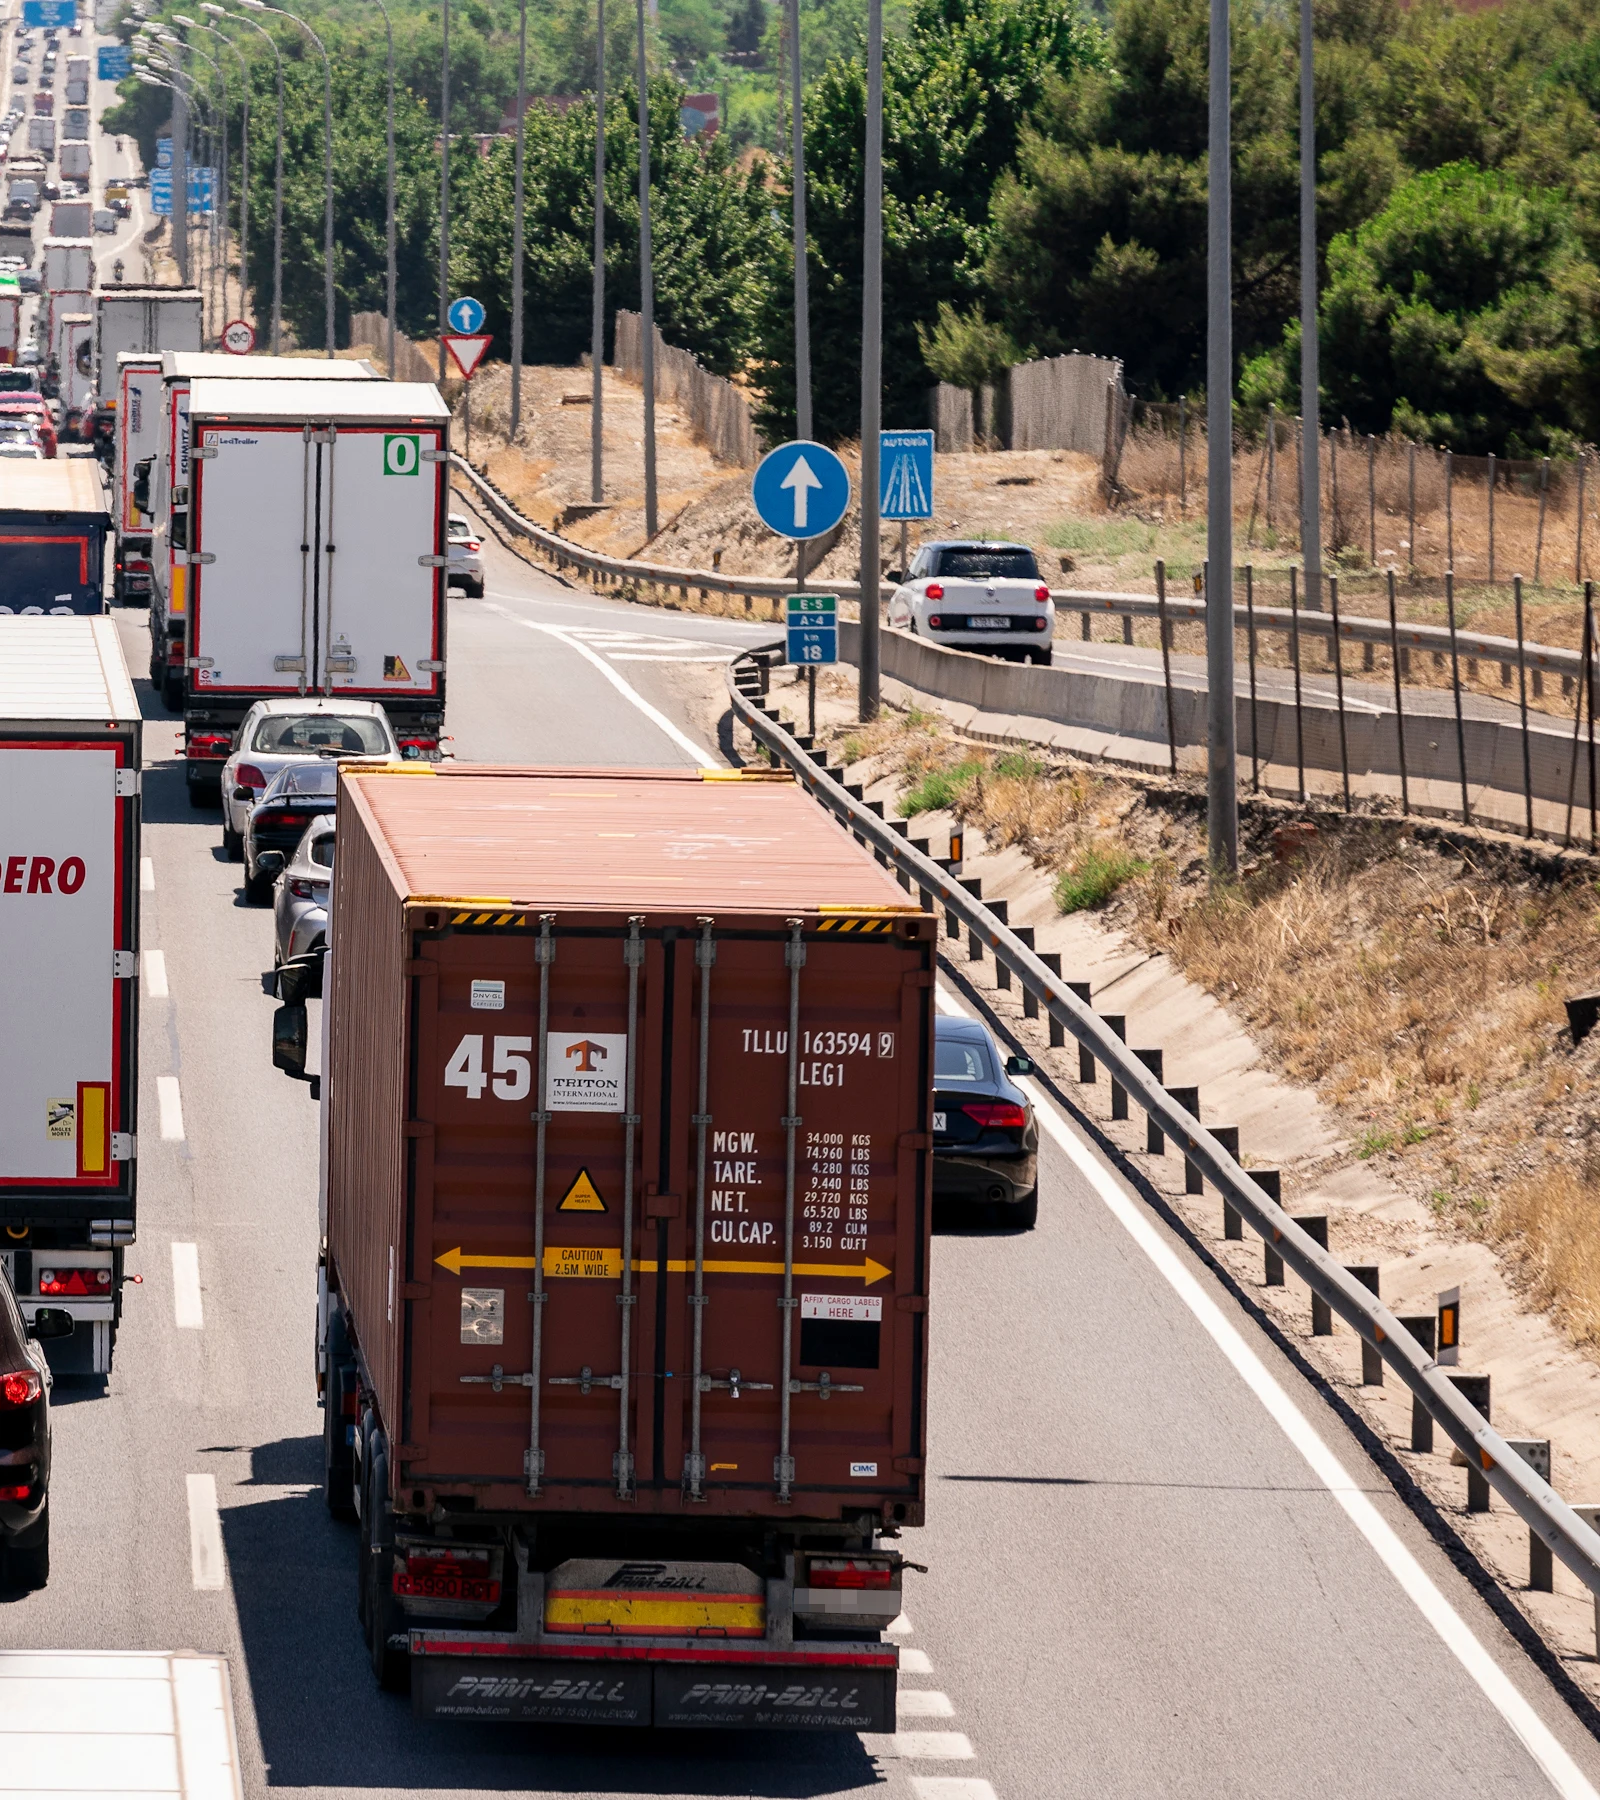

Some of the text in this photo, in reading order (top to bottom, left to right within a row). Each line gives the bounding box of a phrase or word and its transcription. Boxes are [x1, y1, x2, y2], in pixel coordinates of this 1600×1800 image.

[180, 429, 189, 474] SCHMITZ
[387, 437, 416, 473] 0
[800, 599, 824, 610] E-5
[800, 615, 824, 625] A-4
[802, 645, 822, 660] 18
[742, 1029, 892, 1056] TLLU 163594 9
[444, 1034, 532, 1100] 45
[800, 1062, 844, 1087] LEG1
[553, 1078, 618, 1088] TRITON
[553, 1090, 618, 1098] INTERNATIONAL
[713, 1131, 758, 1153] MGW.
[852, 1134, 871, 1146] KGS
[851, 1148, 870, 1160] LBS
[713, 1161, 762, 1184] TARE.
[851, 1164, 869, 1176] KGS
[850, 1178, 869, 1190] LBS
[711, 1190, 749, 1213] NET.
[849, 1193, 868, 1205] KGS
[803, 1206, 867, 1220] 65.520 LBS
[711, 1220, 776, 1245] CU.CAP.
[809, 1222, 833, 1234] 89.2
[803, 1236, 832, 1249] 3.150
[561, 1249, 603, 1261] CAUTION
[555, 1264, 609, 1276] 2.5M WIDE
[803, 1296, 880, 1306] AFFIX CARGO LABELS
[829, 1308, 853, 1318] HERE
[852, 1464, 875, 1472] CIMC
